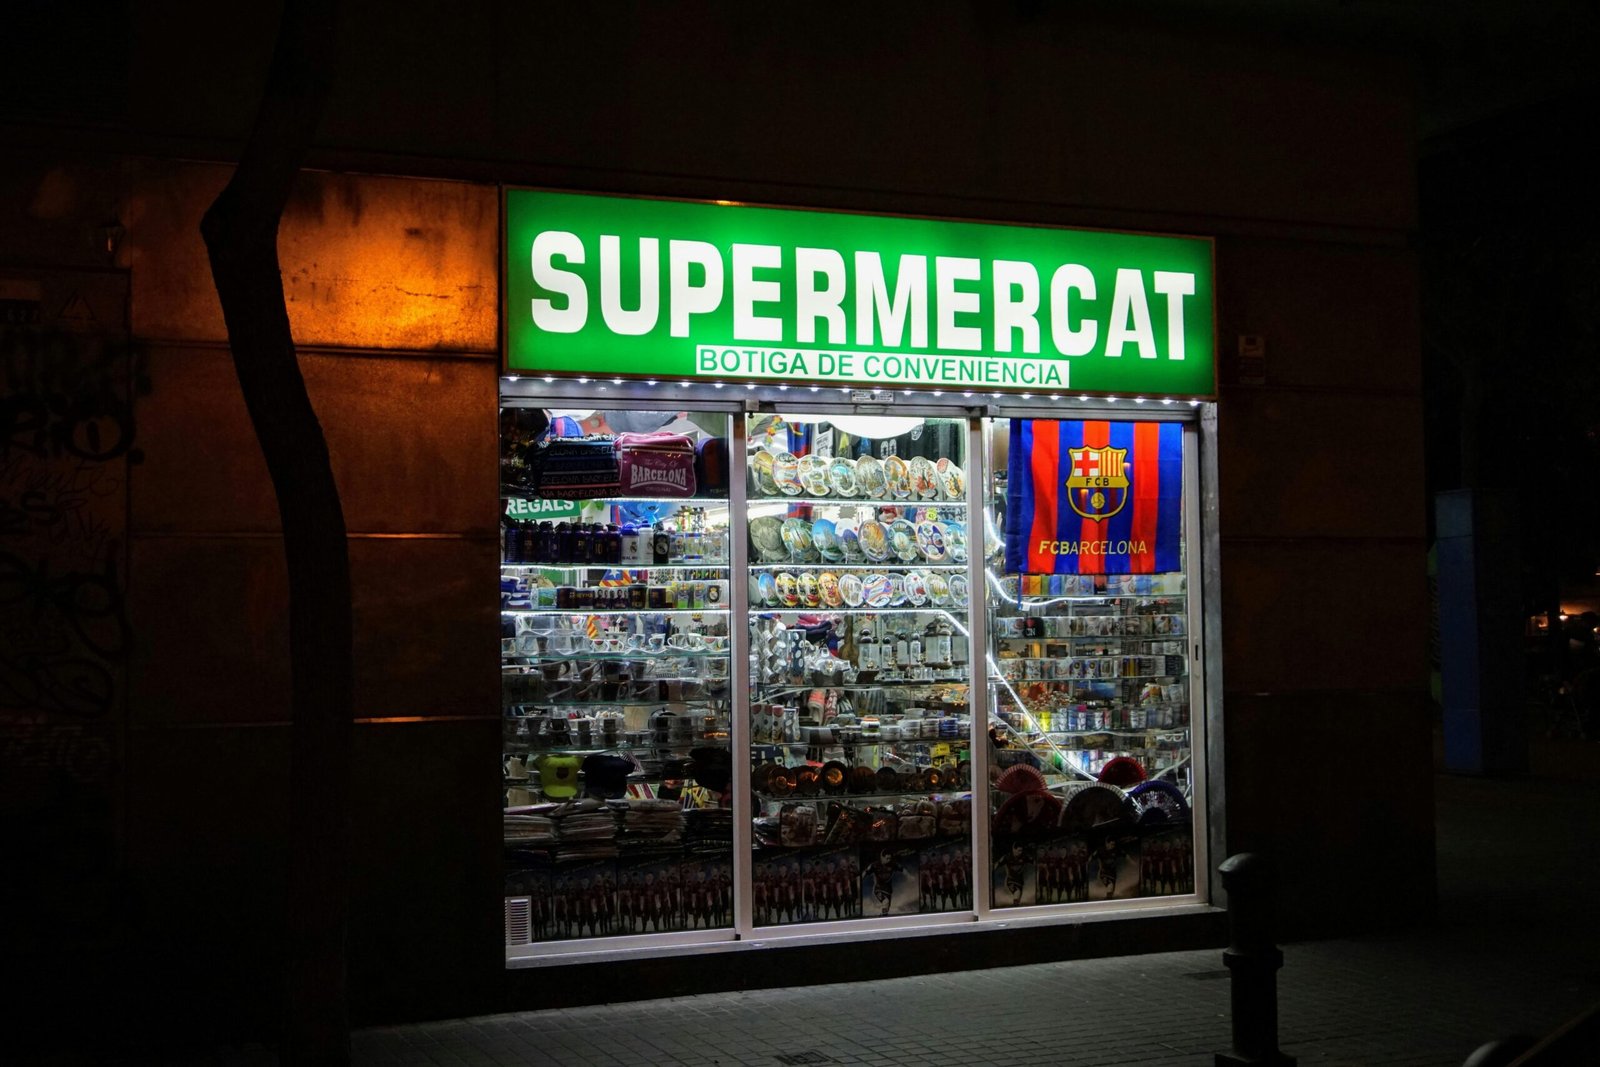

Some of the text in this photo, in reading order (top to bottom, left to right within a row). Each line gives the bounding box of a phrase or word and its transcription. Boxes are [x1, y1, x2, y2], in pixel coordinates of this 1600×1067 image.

[530, 230, 1195, 362] SUPERMERCAT
[700, 348, 808, 375] BOTIGA
[818, 353, 854, 377] DE
[630, 463, 687, 487] BARCELONA
[1085, 477, 1110, 487] FCB
[505, 497, 575, 515] REGALS
[1038, 540, 1148, 556] FCBARCELONA
